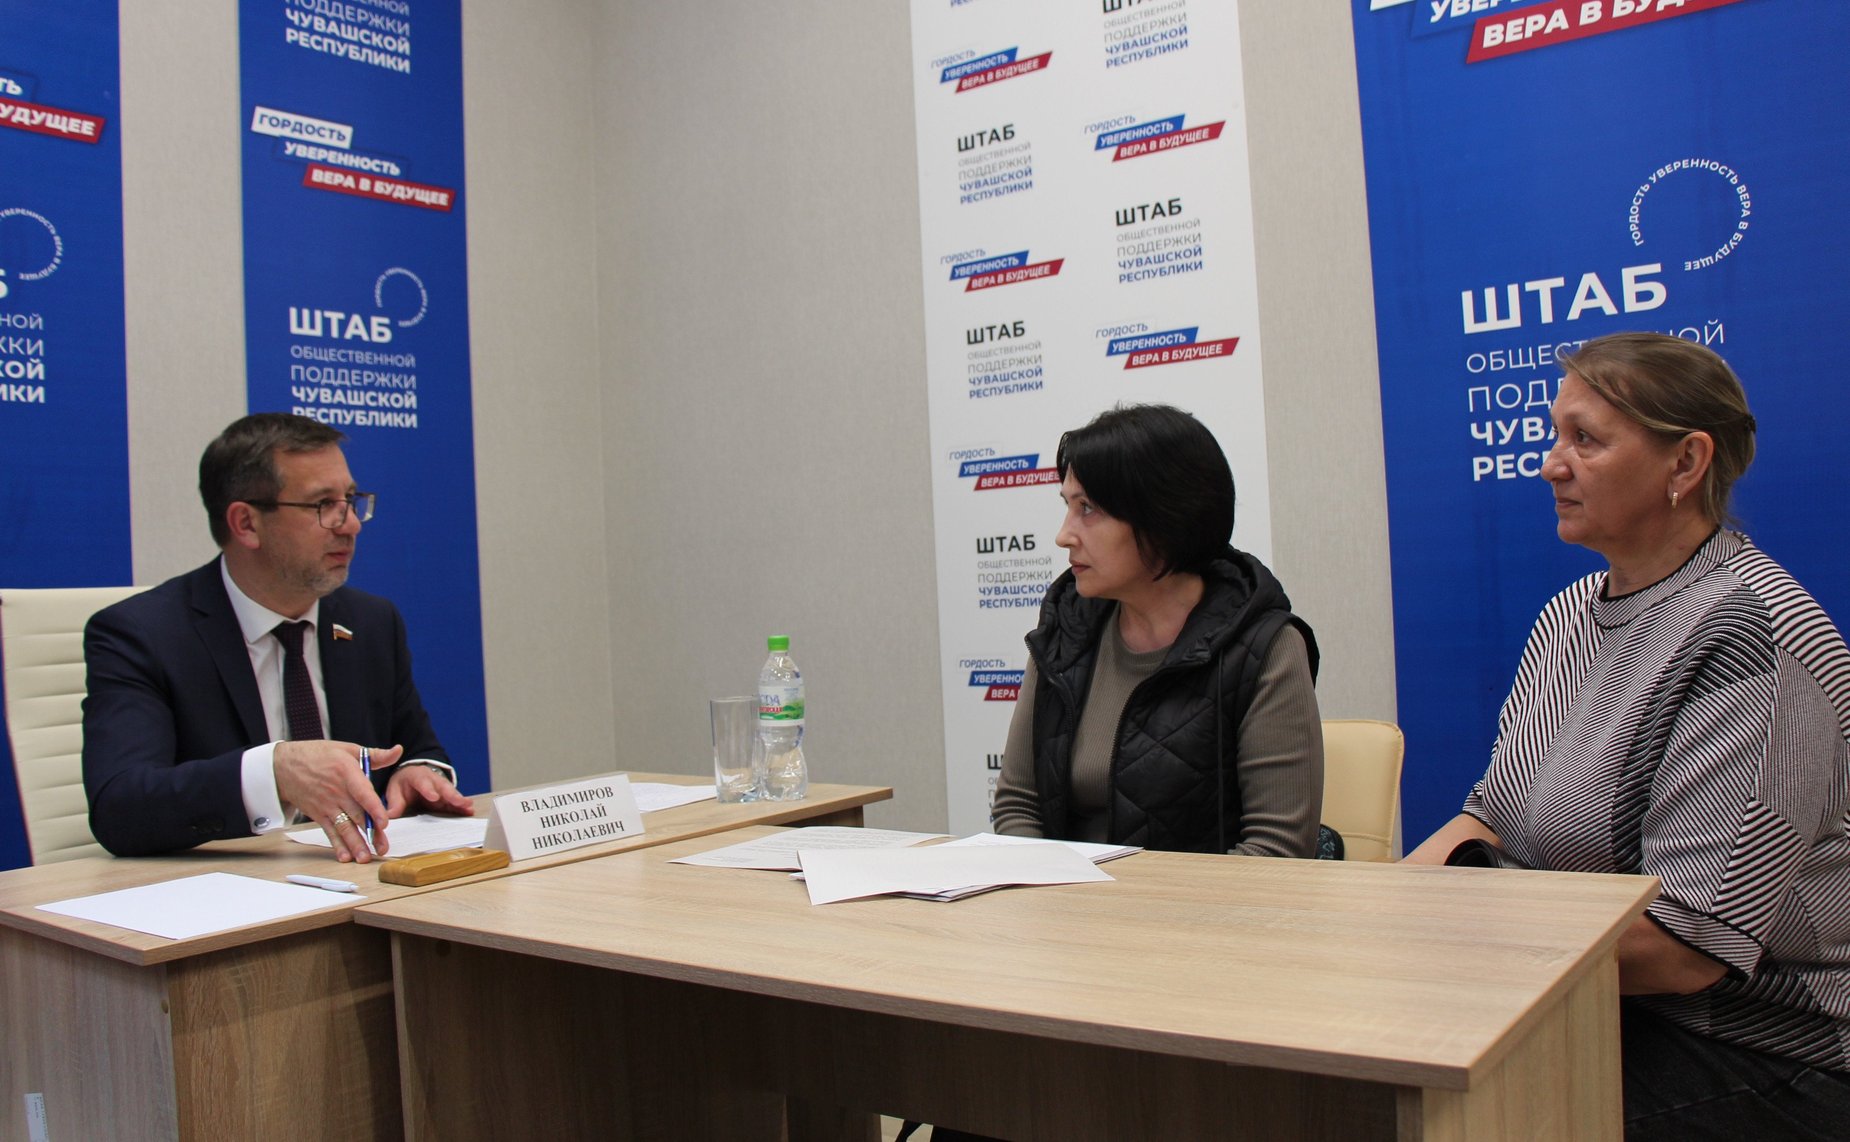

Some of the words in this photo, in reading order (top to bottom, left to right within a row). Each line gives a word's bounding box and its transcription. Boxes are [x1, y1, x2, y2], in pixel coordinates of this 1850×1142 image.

[285, 8, 411, 56] ЧУВАШСКОЙ
[1104, 12, 1188, 43] ПОДДЕРЖКИ
[1482, 9, 1569, 48] ВЕРА
[1579, 1, 1602, 26] В
[286, 27, 411, 75] РЕСПУБЛИКИ
[1105, 24, 1189, 55] ЧУВАШСКОЙ
[930, 49, 976, 69] ГОРДОСТЬ
[1105, 38, 1189, 68] РЕСПУБЛИКИ
[944, 53, 1009, 80] УВЕРЕННОСТЬ
[961, 74, 986, 90] ВЕРА
[987, 71, 994, 82] В
[995, 58, 1040, 80] БУДУЩЕЕ
[0, 103, 96, 137] УДУЩЕЕ
[258, 113, 346, 142] ГОРДОСТЬ
[1084, 115, 1136, 134] ГОРДОСТЬ
[957, 123, 1015, 153] ШТАБ
[1100, 121, 1174, 147] УВЕРЕННОСТЬ
[1120, 143, 1147, 158] ВЕРА
[1149, 140, 1157, 152] В
[1159, 128, 1210, 149] БУДУЩЕЕ
[284, 141, 401, 177] УВЕРЕННОСТЬ
[959, 155, 1032, 181] ПОДДЕРЖКИ
[1649, 158, 1738, 184] УВЕРЕННОСТЬ
[311, 168, 356, 190] ВЕРА
[359, 177, 371, 191] В
[373, 180, 449, 206] БУДУЩЕЕ
[960, 166, 1032, 192] ЧУВАШСКОЙ
[960, 180, 1033, 205] РЕСПУБЛИКИ
[1736, 185, 1751, 218] ВЕРА
[1115, 198, 1182, 227] ШТАБ
[1629, 183, 1650, 246] ГОРДОСТЬ
[1116, 218, 1201, 242] ОБЩЕСТВЕННОЙ
[1738, 221, 1749, 230] В
[940, 249, 986, 265] ГОРДОСТЬ
[1117, 232, 1202, 257] ПОДДЕРЖКИ
[1684, 232, 1743, 271] БУДУЩЕЕ
[954, 256, 1019, 278] УВЕРЕННОСТЬ
[1118, 245, 1203, 270] ЧУВАШСКОЙ
[971, 275, 995, 289] ВЕРА
[997, 273, 1004, 284] В
[1005, 264, 1051, 282] БУДУЩЕЕ
[1119, 260, 1203, 284] РЕСПУБЛИКИ
[1461, 263, 1667, 334] ШТАБ
[289, 306, 393, 343] ШТАБ
[967, 320, 1025, 345] ШТАБ
[1095, 323, 1149, 338] ГОРДОСТЬ
[967, 340, 1042, 361] ОБЩЕСТВЕННОЙ
[1112, 333, 1187, 353] УВЕРЕННОСТЬ
[1132, 352, 1159, 366] ВЕРА
[1162, 350, 1170, 362] В
[1171, 343, 1223, 361] БУДУЩЕЕ
[290, 344, 416, 368] ОБЩЕСТВЕННОЙ
[968, 354, 1043, 374] ПОДДЕРЖКИ
[290, 364, 417, 390] ПОДДЕРЖКИ
[968, 365, 1043, 386] ЧУВАШСКОЙ
[291, 385, 418, 410] ЧУВАШСКОЙ
[969, 380, 1044, 399] РЕСПУБЛИКИ
[292, 406, 418, 429] РЕСПУБЛИКИ
[949, 448, 995, 461] ГОРДОСТЬ
[963, 459, 1029, 474] УВЕРЕННОСТЬ
[981, 476, 1005, 487] ВЕРА
[1007, 475, 1014, 485] В
[976, 534, 1036, 554] ШТАБ
[977, 555, 1052, 570] ОБЩЕСТВЕННОЙ
[978, 570, 1053, 584] ПОДДЕРЖКИ
[979, 597, 1042, 609] РЕСПУБЛИ
[959, 659, 1006, 669] ГОРДОСТЬ
[973, 673, 1025, 684] УВЕРЕННО
[991, 689, 1015, 699] ВЕРА
[521, 786, 614, 813] ВЛАДИМИРОВ
[540, 802, 608, 829] НИКОЛАЙ
[532, 820, 625, 850] НИКОЛАЕВИЧ
